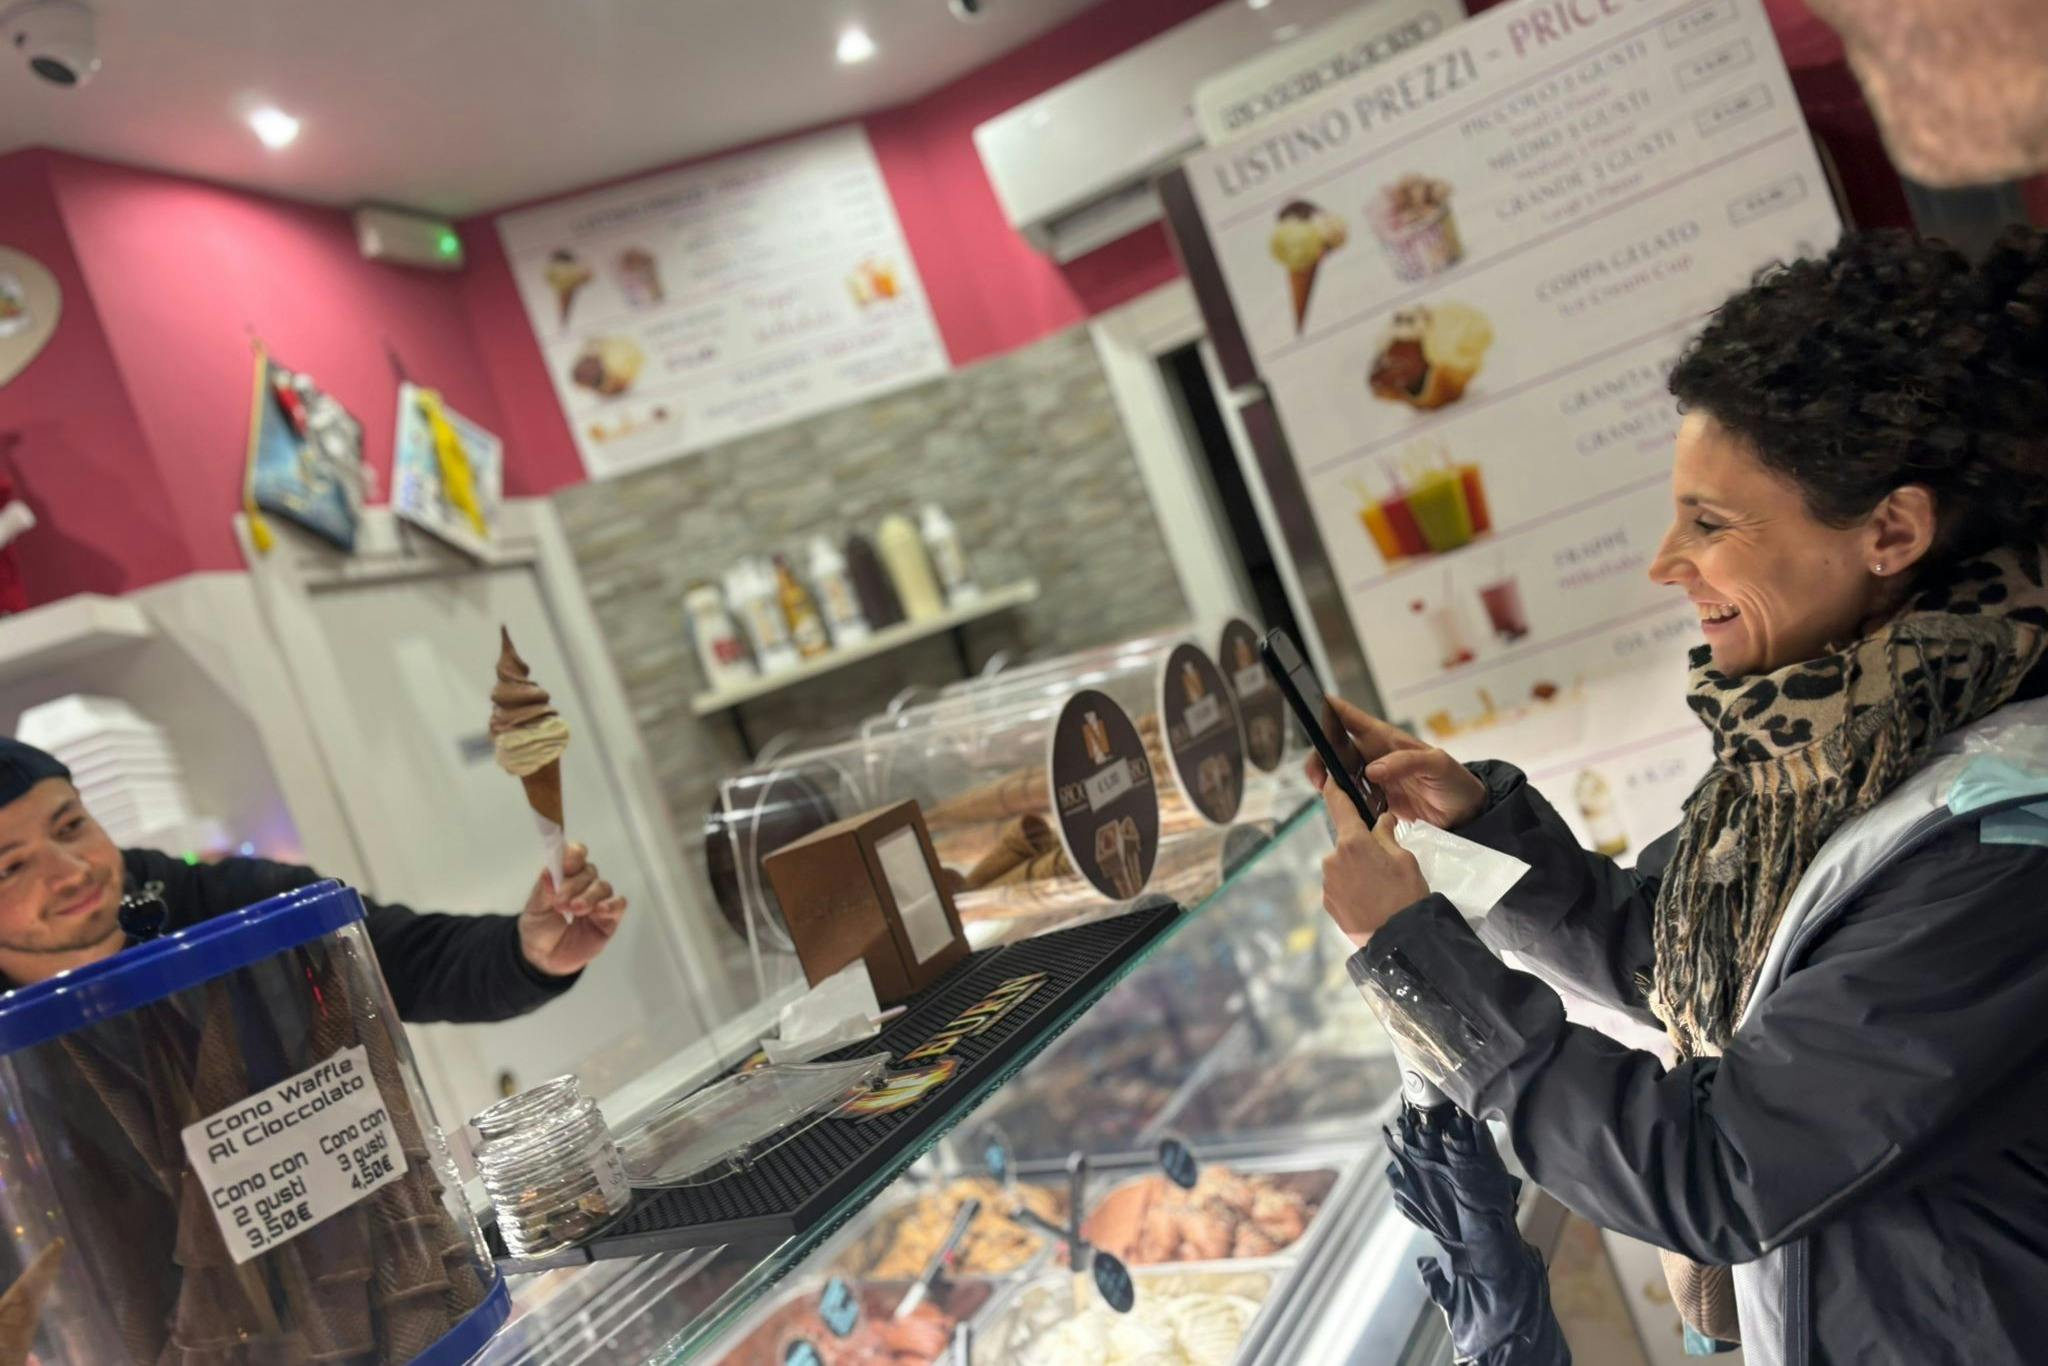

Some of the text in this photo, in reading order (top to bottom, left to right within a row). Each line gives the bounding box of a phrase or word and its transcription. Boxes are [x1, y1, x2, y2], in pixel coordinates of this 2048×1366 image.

[1213, 108, 1350, 197] LISTINO
[1353, 46, 1479, 132] PREZZI
[1610, 219, 1701, 268] GELATO
[205, 1059, 354, 1140] Cono Waffle
[242, 1075, 365, 1146] Cioccolato
[319, 1108, 387, 1155] Cono con
[337, 1130, 388, 1172] 3 gusti
[212, 1151, 310, 1210] Cono con
[351, 1154, 395, 1191] 4,50€
[232, 1175, 307, 1227] 2 gusti
[246, 1201, 313, 1249] 3,50€
